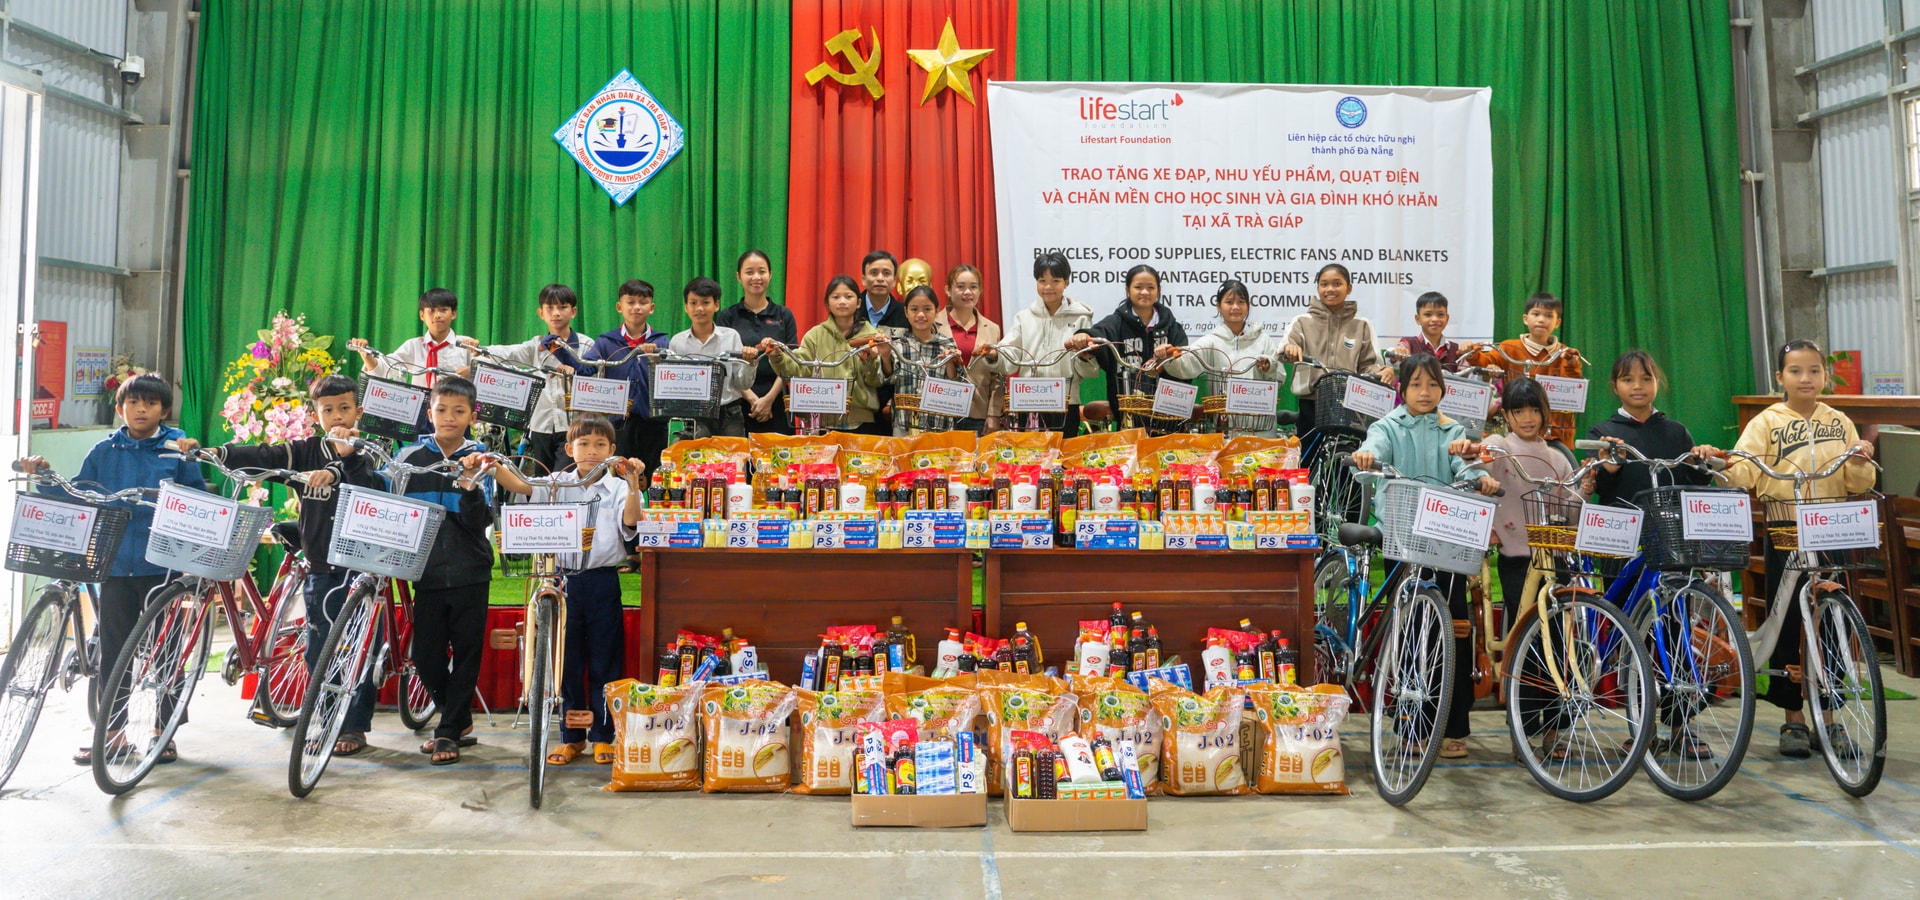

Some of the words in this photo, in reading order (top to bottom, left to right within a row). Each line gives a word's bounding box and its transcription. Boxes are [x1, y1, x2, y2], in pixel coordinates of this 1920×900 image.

[1080, 97, 1168, 120] lifestart
[1080, 136, 1117, 144] Lifestart
[1120, 136, 1171, 144] Foundation
[1308, 134, 1326, 145] hiệp
[1328, 134, 1342, 142] các
[1355, 134, 1376, 143] chức
[1339, 146, 1355, 156] phố
[1062, 168, 1102, 180] TRAO
[1107, 165, 1148, 182] TẶNG
[1153, 169, 1171, 180] XE
[1175, 168, 1210, 183] ĐẠP,
[1215, 169, 1248, 181] NHU
[1252, 164, 1280, 181] YẾU
[1286, 164, 1334, 183] PHẨM,
[1339, 170, 1381, 185] QUẠT
[1386, 168, 1419, 183] ĐIỆN
[1042, 188, 1063, 204] VÀ
[1068, 188, 1110, 204] CHĂN
[1115, 187, 1149, 204] MỀN
[1154, 191, 1185, 204] CHO
[1190, 192, 1222, 206] HỌC
[1226, 192, 1260, 205] SINH
[1266, 190, 1286, 205] VÀ
[1290, 193, 1316, 205] GIA
[1320, 190, 1357, 205] ĐÌNH
[1363, 190, 1394, 206] KHÓ
[1398, 191, 1438, 207] KHĂN
[1183, 215, 1206, 230] TẠI
[1211, 212, 1231, 227] XÃ
[1235, 213, 1263, 227] TRÀ
[1268, 213, 1303, 228] GIÁP
[1034, 248, 1103, 261] BICYCLES,
[1109, 248, 1150, 259] FOOD
[1155, 248, 1226, 262] SUPPLIES,
[1231, 248, 1296, 260] ELECTRIC
[1301, 249, 1336, 260] FANS
[1341, 249, 1373, 261] AND
[1379, 249, 1448, 262] BLANKETS
[1071, 271, 1100, 283] FOR
[1234, 272, 1309, 284] STUDENTS
[1351, 273, 1413, 285] FAMILIES
[1176, 295, 1205, 306] TRA
[479, 373, 518, 390] lifestart
[659, 370, 699, 381] lifestart
[577, 382, 617, 395] lifestart
[795, 384, 834, 395] lifestart
[928, 383, 962, 398] lifestart
[1015, 383, 1053, 393] lifestart
[1160, 384, 1189, 399] lifestart
[1232, 384, 1267, 396] lifestart
[1351, 383, 1385, 400] lifestart
[371, 386, 410, 405] lifestart
[165, 496, 218, 521] lifestart
[355, 500, 408, 524] lifestart
[1426, 497, 1478, 522] lifestart
[1689, 500, 1738, 515] lifestart
[22, 504, 76, 527] lifestart
[509, 514, 564, 527] lifestart
[1586, 513, 1629, 530] lifestart
[1805, 513, 1860, 527] lifestart
[646, 718, 684, 730] J-02
[740, 722, 776, 736] J-02
[1295, 727, 1333, 741] J-02
[1198, 734, 1234, 749] J-02
